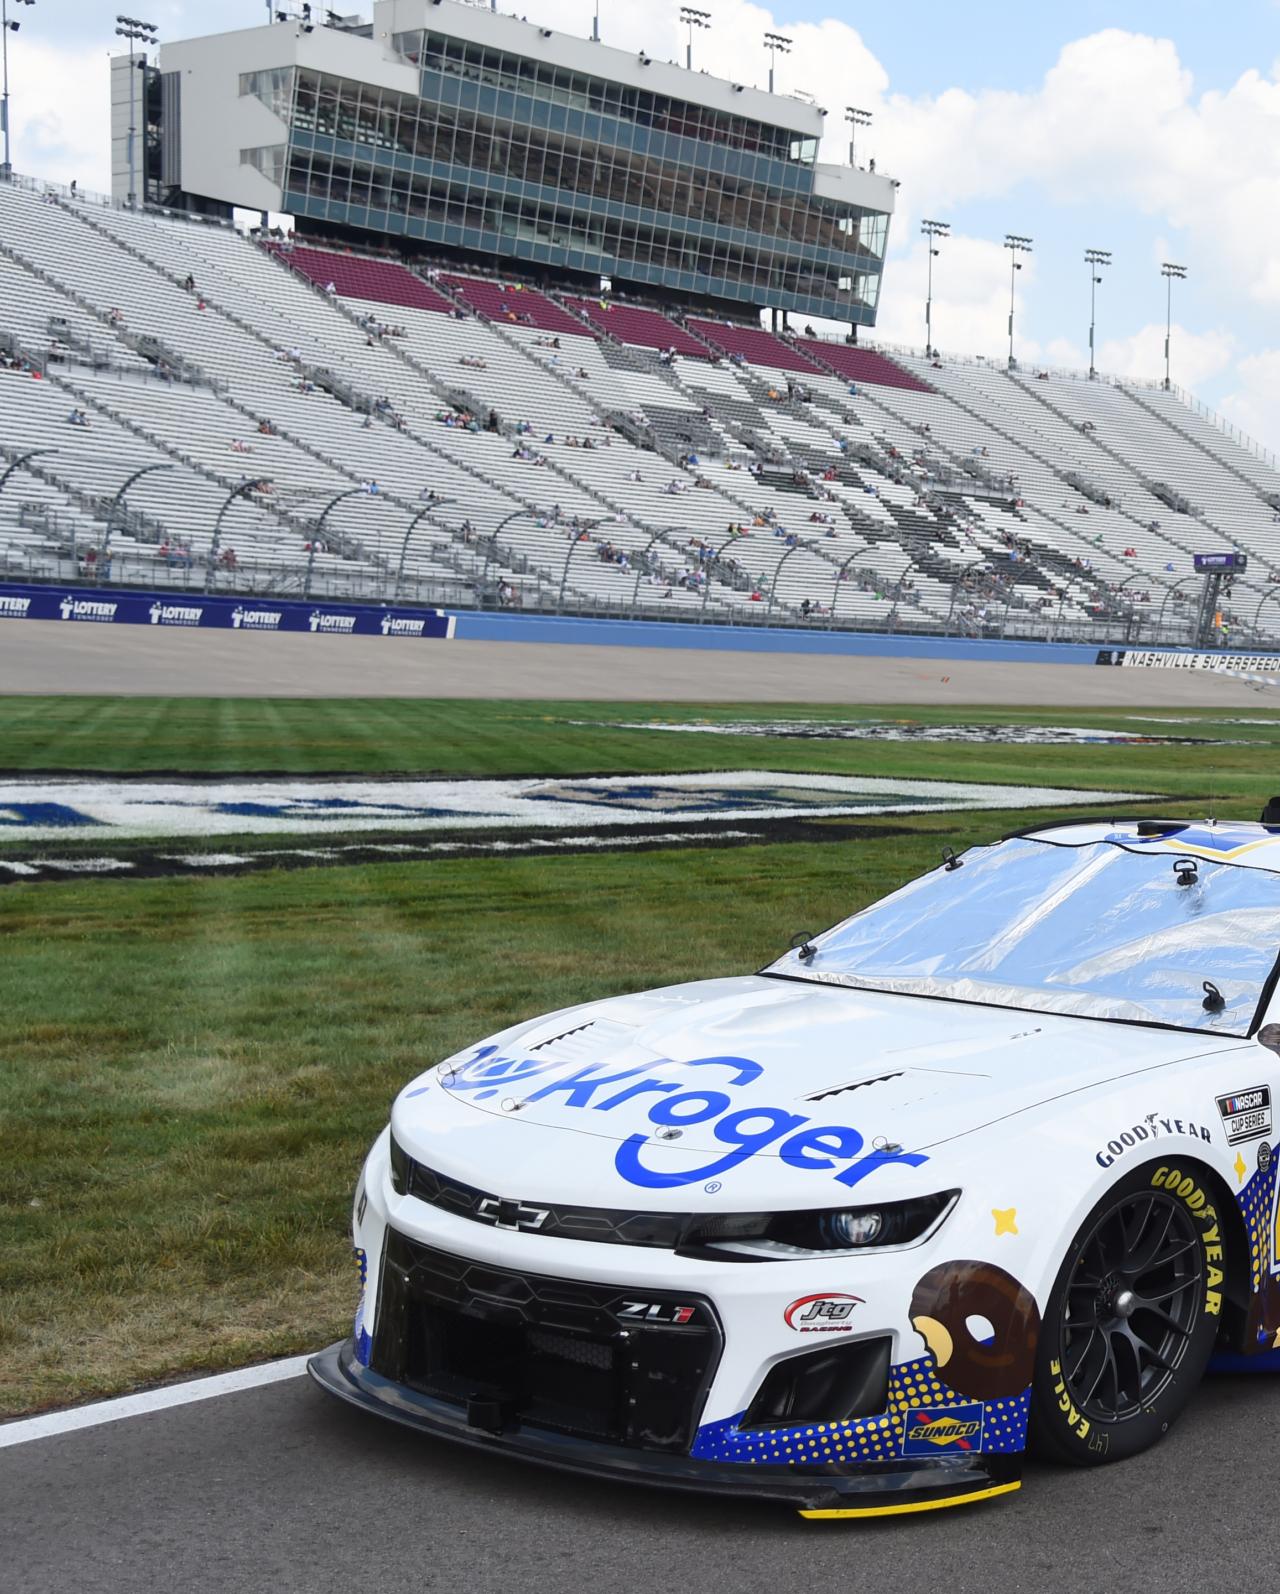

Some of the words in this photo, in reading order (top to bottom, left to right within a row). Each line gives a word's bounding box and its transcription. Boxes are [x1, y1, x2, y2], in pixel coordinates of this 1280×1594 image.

[0, 597, 31, 611] TTERY
[73, 601, 117, 615] LOTTERY
[162, 607, 203, 620] LOTTERY
[243, 611, 282, 624] LOTTERY
[320, 615, 356, 628] LOTTERY
[391, 619, 425, 631] LOTTERY
[1129, 653, 1199, 669] NASHVILLE
[1234, 1091, 1263, 1110] NASCAR
[527, 1056, 930, 1189] Kroger
[1231, 1118, 1245, 1133] CUP
[1244, 1112, 1265, 1130] SERIES
[616, 1301, 696, 1323] ZL1
[1050, 1357, 1090, 1439] EAGLE
[910, 1421, 979, 1439] SUNOCO
